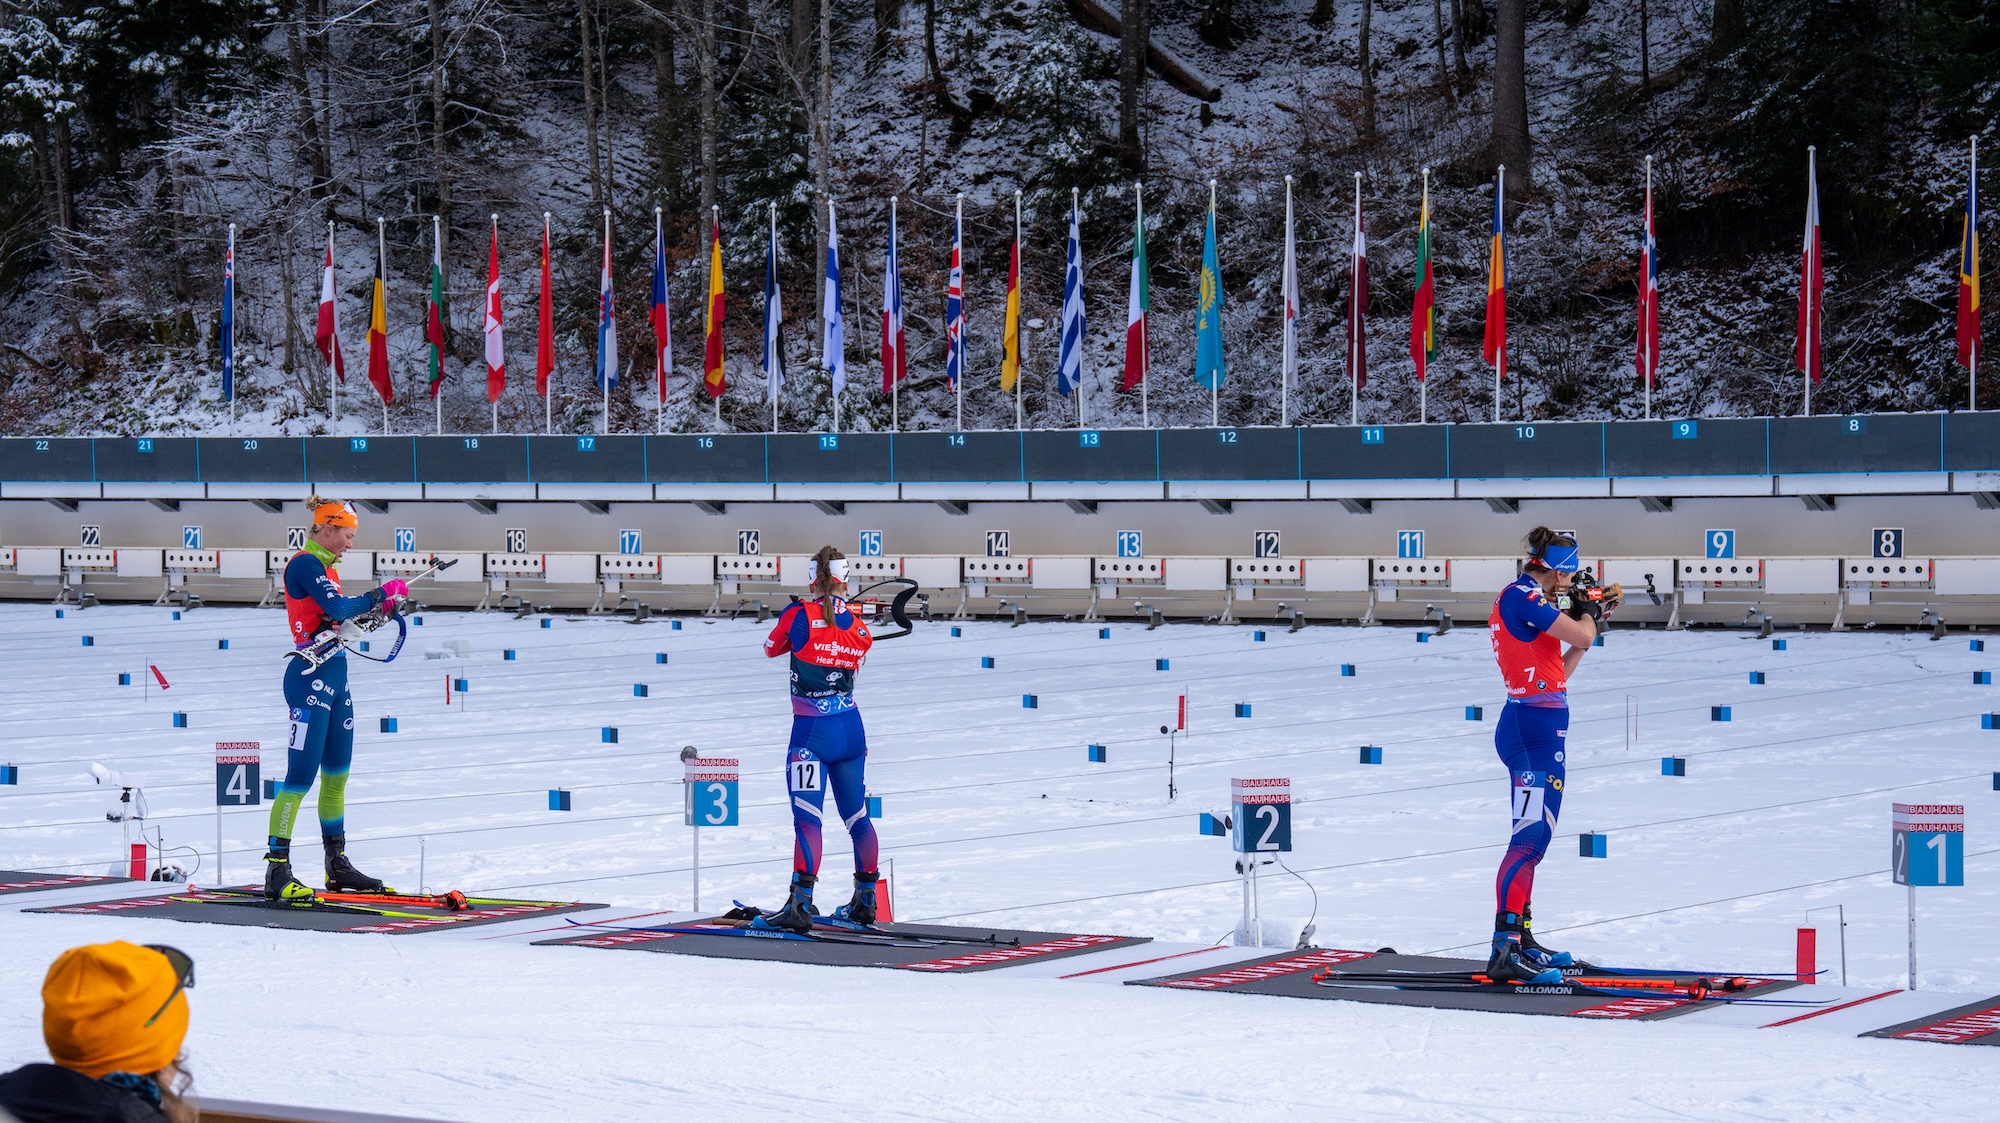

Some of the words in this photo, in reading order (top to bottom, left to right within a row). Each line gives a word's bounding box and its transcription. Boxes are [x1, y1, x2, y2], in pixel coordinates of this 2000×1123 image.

[1364, 430, 1380, 440] 11
[1516, 426, 1534, 438] 10
[1680, 423, 1690, 435] 9
[1849, 419, 1859, 432] 8
[36, 440, 49, 450] 22
[138, 440, 151, 450] 21
[244, 440, 258, 450] 20
[352, 440, 366, 450] 19
[464, 438, 478, 448] 18
[580, 438, 594, 448] 17
[698, 438, 712, 448] 16
[821, 436, 836, 447] 15
[950, 435, 965, 445] 14
[1082, 434, 1098, 444] 13
[1220, 432, 1237, 442] 12
[82, 528, 98, 547] 22
[185, 528, 200, 549] 21
[288, 528, 306, 550] 20
[397, 530, 414, 552] 19
[508, 530, 525, 552] 18
[622, 532, 640, 553] 17
[740, 532, 758, 554] 16
[861, 532, 880, 554] 15
[988, 532, 1008, 555] 14
[1119, 532, 1140, 556] 13
[1256, 532, 1279, 557] 12
[1400, 532, 1422, 556] 11
[1712, 532, 1728, 556] 9
[1880, 530, 1896, 558] 8
[294, 620, 303, 633] 3
[816, 656, 834, 664] Heat
[1524, 666, 1536, 682] 7
[290, 724, 298, 746] 3
[226, 764, 250, 804] 4
[797, 764, 815, 789] 12
[1242, 779, 1290, 788] BAUHAUS
[705, 782, 728, 825] 3
[1243, 794, 1290, 804] BAUHAUS
[1520, 790, 1532, 818] 7
[278, 802, 293, 836] SLOVENIA
[1909, 805, 1964, 814] BAUHAUS
[1234, 804, 1242, 850] 3
[1255, 804, 1280, 851] 2
[1909, 823, 1964, 832] BAUHAUS
[1896, 832, 1905, 883] 2
[1926, 834, 1946, 884] 1
[744, 930, 784, 938] SALOMON
[906, 936, 1114, 970] BAUHAUS
[1168, 950, 1366, 988] BAUHAUS
[1514, 986, 1573, 994] SALOMON
